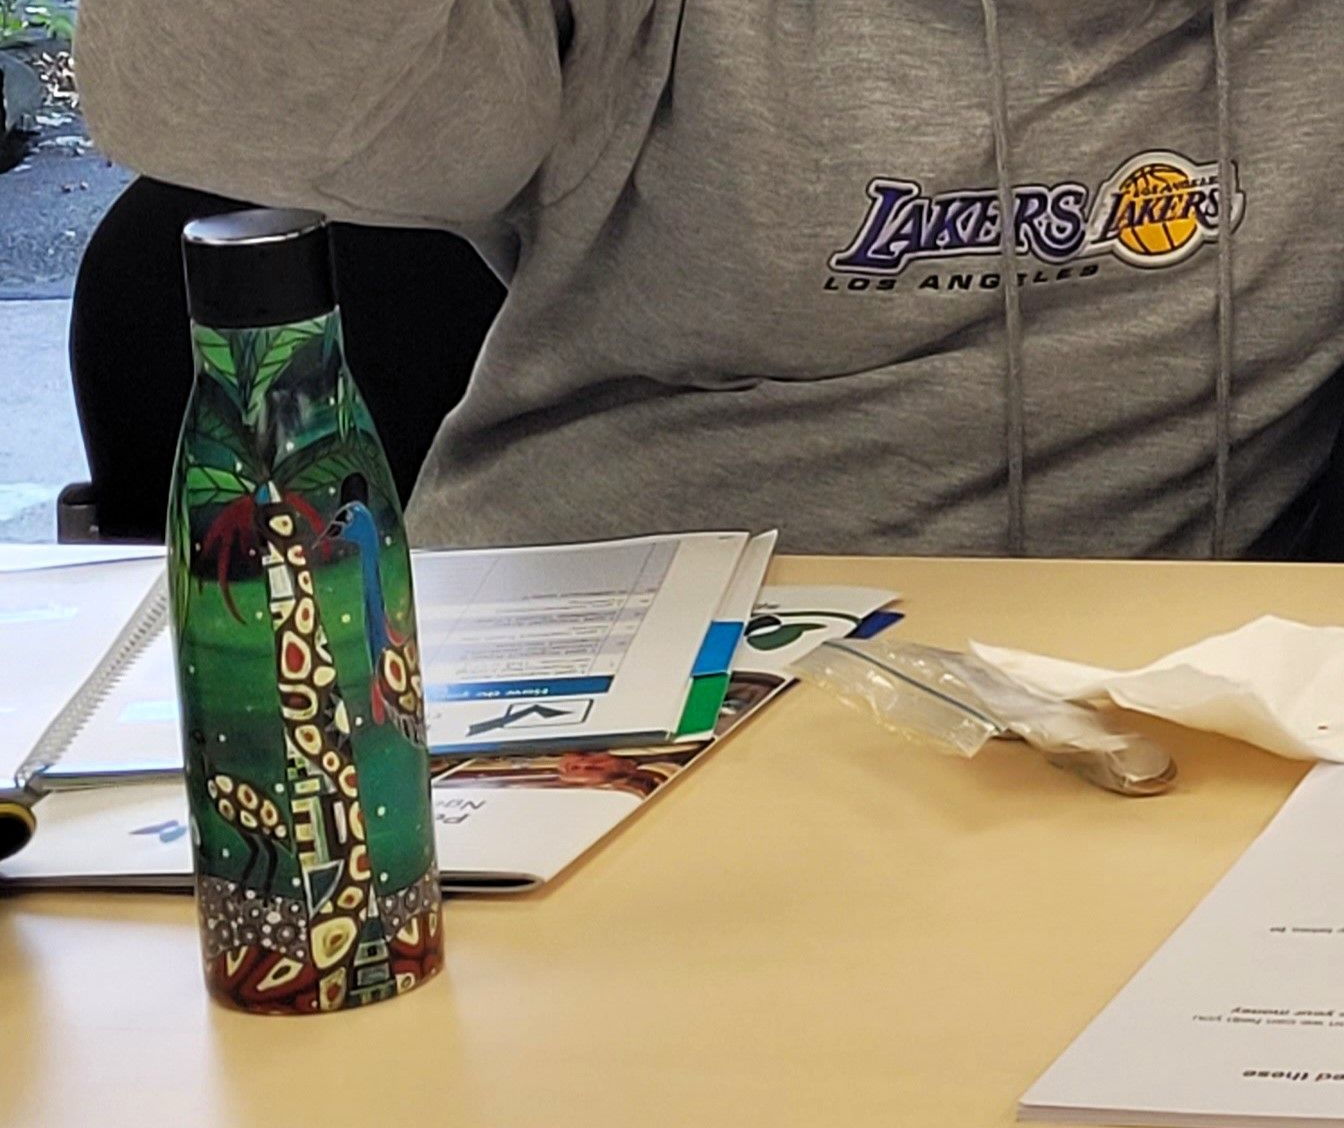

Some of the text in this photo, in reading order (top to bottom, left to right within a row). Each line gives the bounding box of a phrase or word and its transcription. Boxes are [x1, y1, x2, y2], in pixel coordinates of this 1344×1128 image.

[832, 178, 1088, 271] LAKERS
[1096, 188, 1220, 242] LAKERS
[823, 276, 894, 292] LOS
[1242, 1070, 1309, 1082] these
